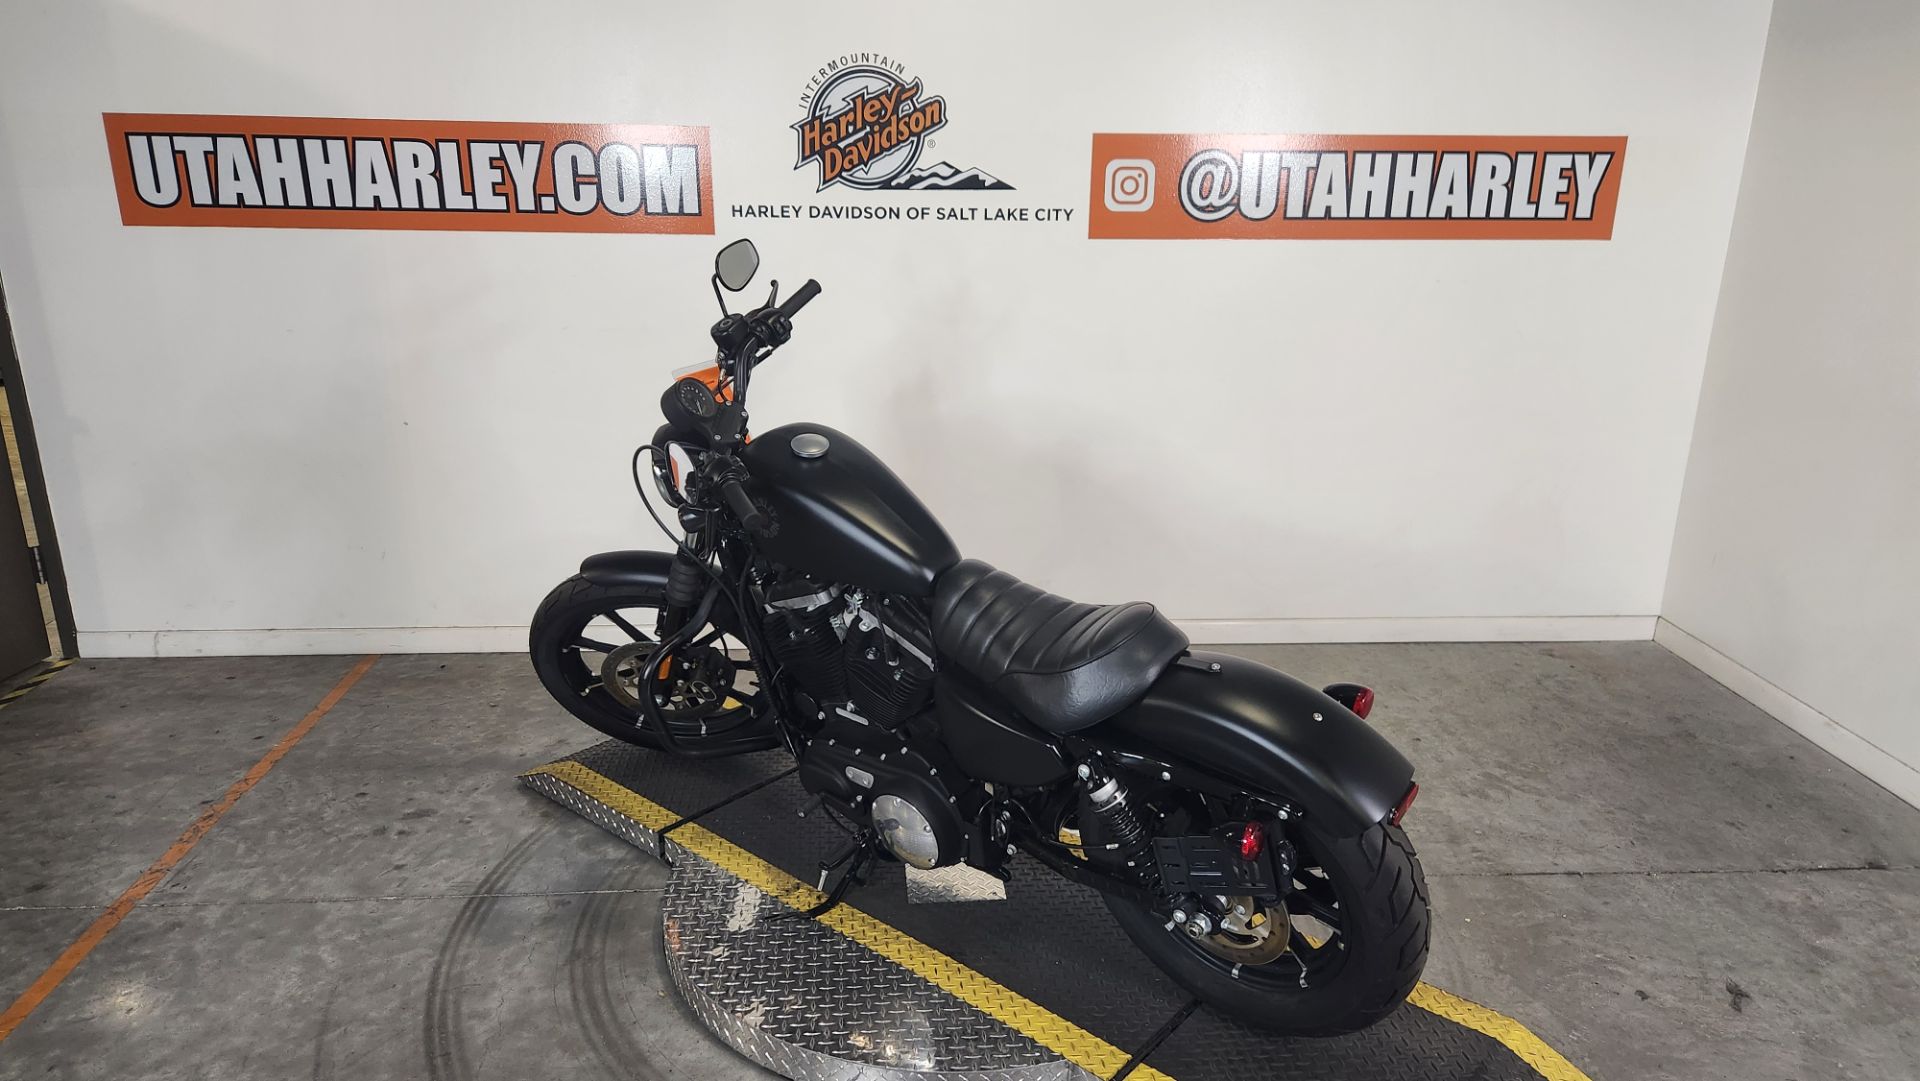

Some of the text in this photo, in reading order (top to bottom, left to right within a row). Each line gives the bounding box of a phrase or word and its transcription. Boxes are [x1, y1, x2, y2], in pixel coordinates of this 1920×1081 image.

[799, 52, 905, 109] INTERMOUNTAIN
[125, 132, 701, 216] UTAHHARLEY.COM
[825, 99, 941, 181] Davidson
[731, 205, 1074, 221] HARLEY DAVIDSON OF SALT LAKE CITY
[1179, 148, 1615, 222] @UTAHHARLEY
